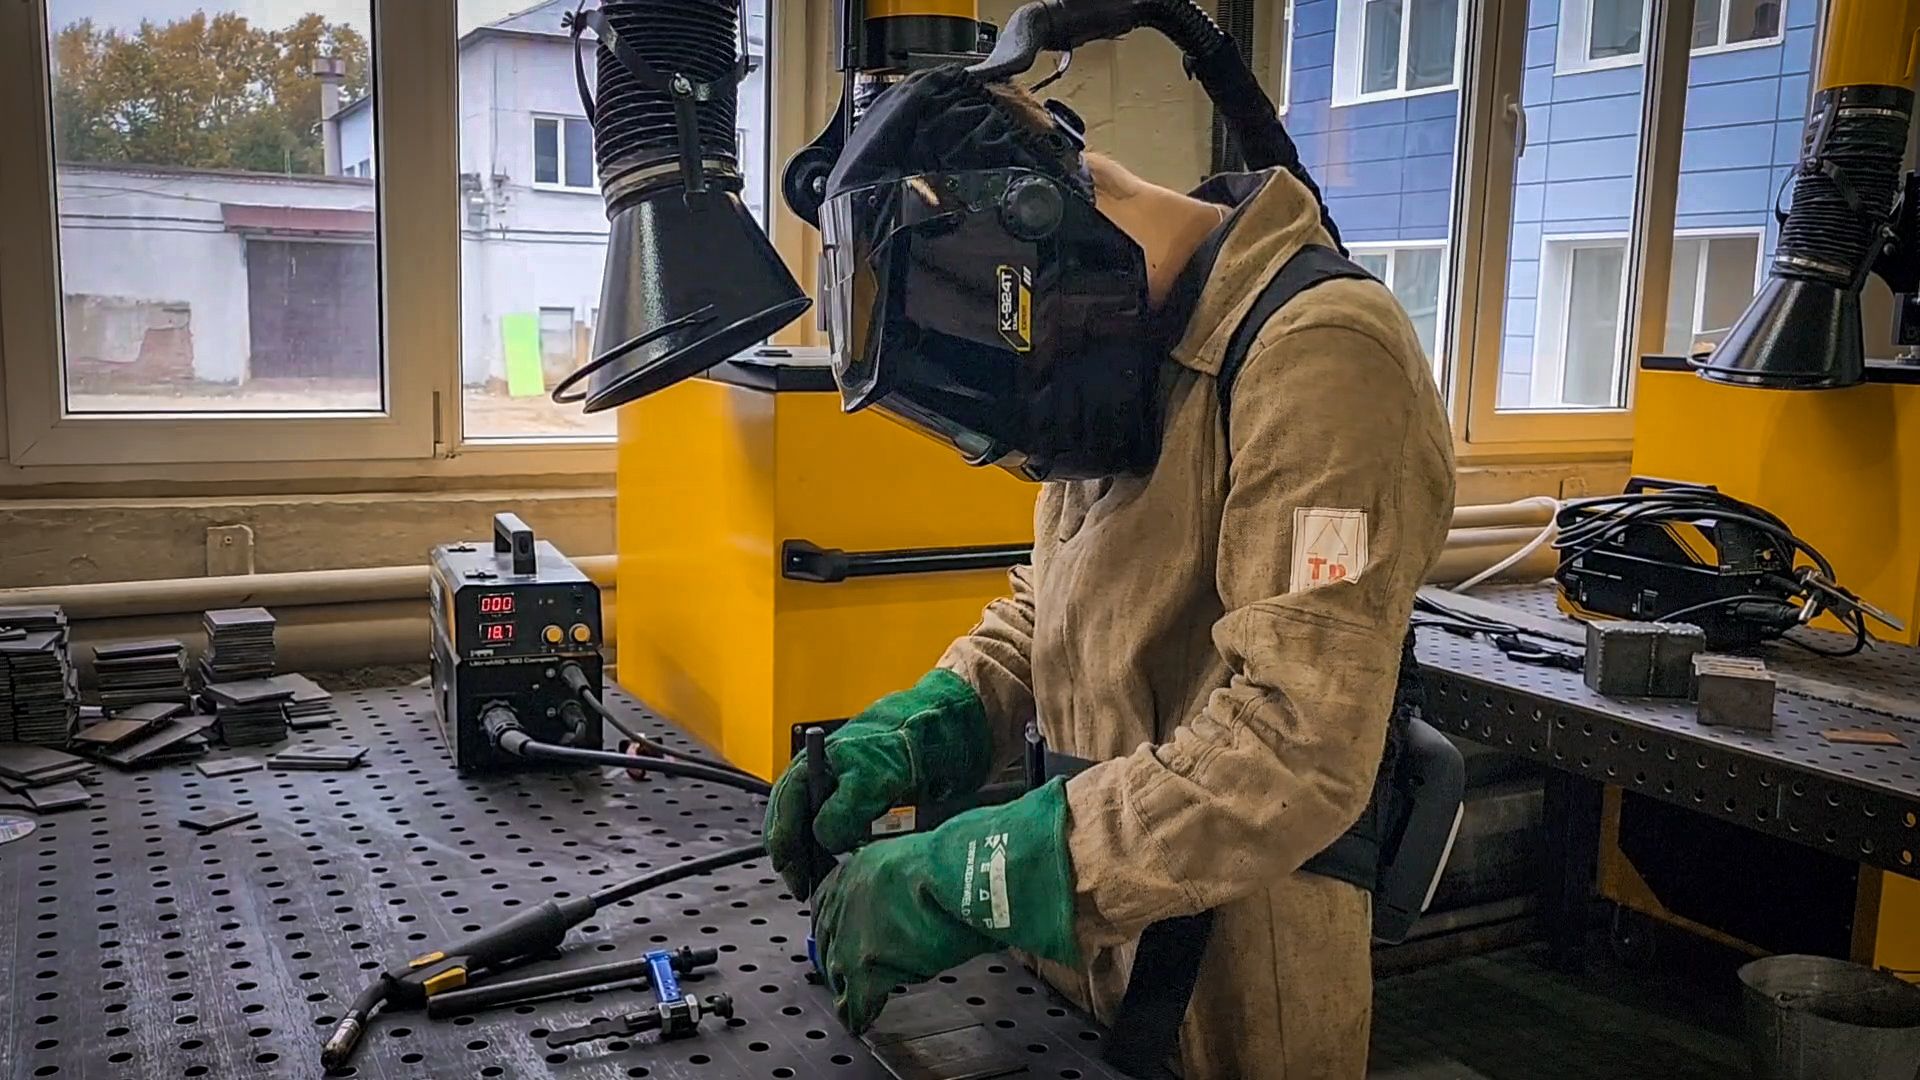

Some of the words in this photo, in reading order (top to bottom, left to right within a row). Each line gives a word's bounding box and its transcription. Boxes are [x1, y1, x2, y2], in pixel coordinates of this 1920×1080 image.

[1001, 271, 1012, 331] K-924T
[481, 596, 513, 612] 000
[487, 625, 513, 640] 18.7
